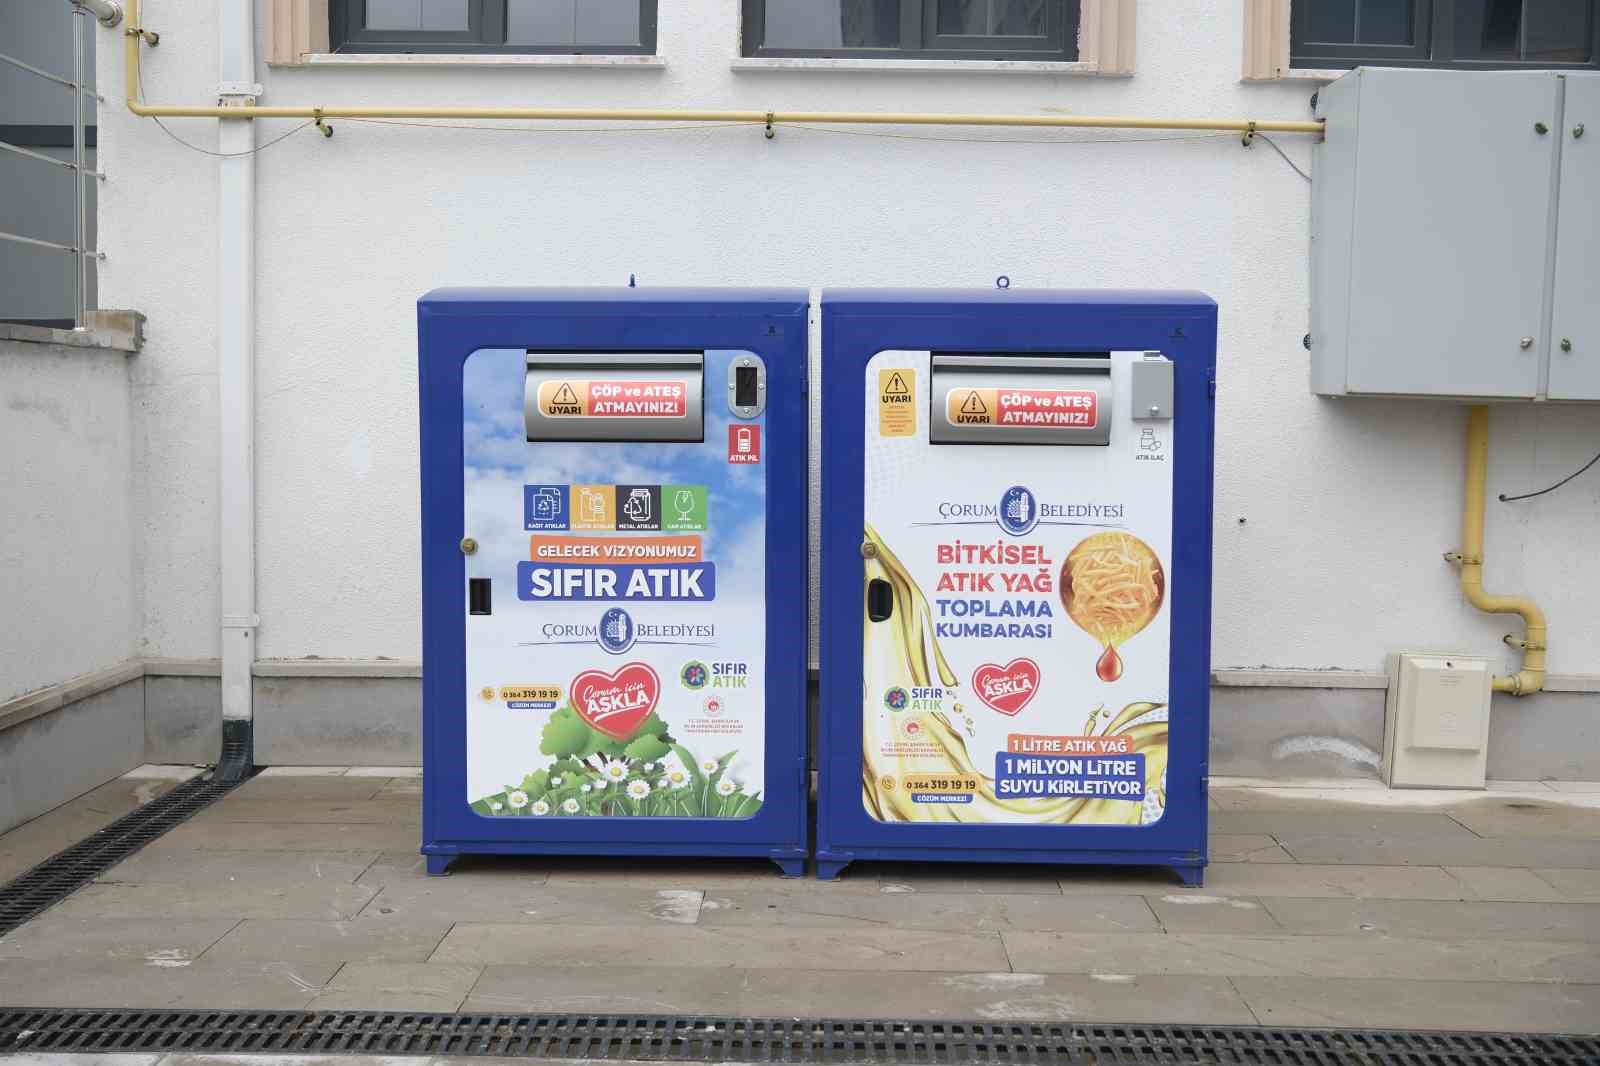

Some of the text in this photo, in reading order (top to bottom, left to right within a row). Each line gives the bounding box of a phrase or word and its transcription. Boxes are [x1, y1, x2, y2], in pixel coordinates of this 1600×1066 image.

[592, 384, 681, 399] ÇÖP ve ATEŞ
[882, 395, 912, 403] UYARI
[594, 401, 678, 413] ATMAYINIZ!
[1001, 392, 1092, 409] ÇÖP ve ATEŞ
[548, 406, 582, 415] UYARI
[1003, 411, 1088, 424] ATMAYINIZ!
[957, 415, 990, 424] UYARI
[730, 454, 747, 462] ATIK
[938, 502, 1124, 518] ÇORUM BELEDİYESİ
[537, 543, 697, 558] GELECEK VİZYONUMUZ
[936, 540, 1053, 565] BİTKİSEL
[531, 568, 705, 598] SIFIR ATIK
[936, 568, 1053, 593] ATIK YAĞ
[936, 599, 1053, 618] TOPLAMA
[542, 623, 714, 639] ÇORUM BELEDİYESİ
[936, 623, 1053, 639] KUMBARASI
[712, 663, 747, 675] SIFIR
[713, 676, 747, 688] ATIK
[522, 690, 537, 698] 319
[538, 690, 548, 698] 19
[550, 690, 559, 698] 19
[911, 688, 943, 699] SIFIR
[912, 699, 942, 710] ATIK
[1013, 738, 1128, 753] 1 LİTRE ATIK YAĞ
[1005, 759, 1136, 776] 1 MİLYON LİTRE
[931, 780, 948, 789] 319
[951, 780, 961, 789] 19
[964, 780, 976, 789] 19
[1000, 779, 1142, 795] SUYU KİRLETİYOR
